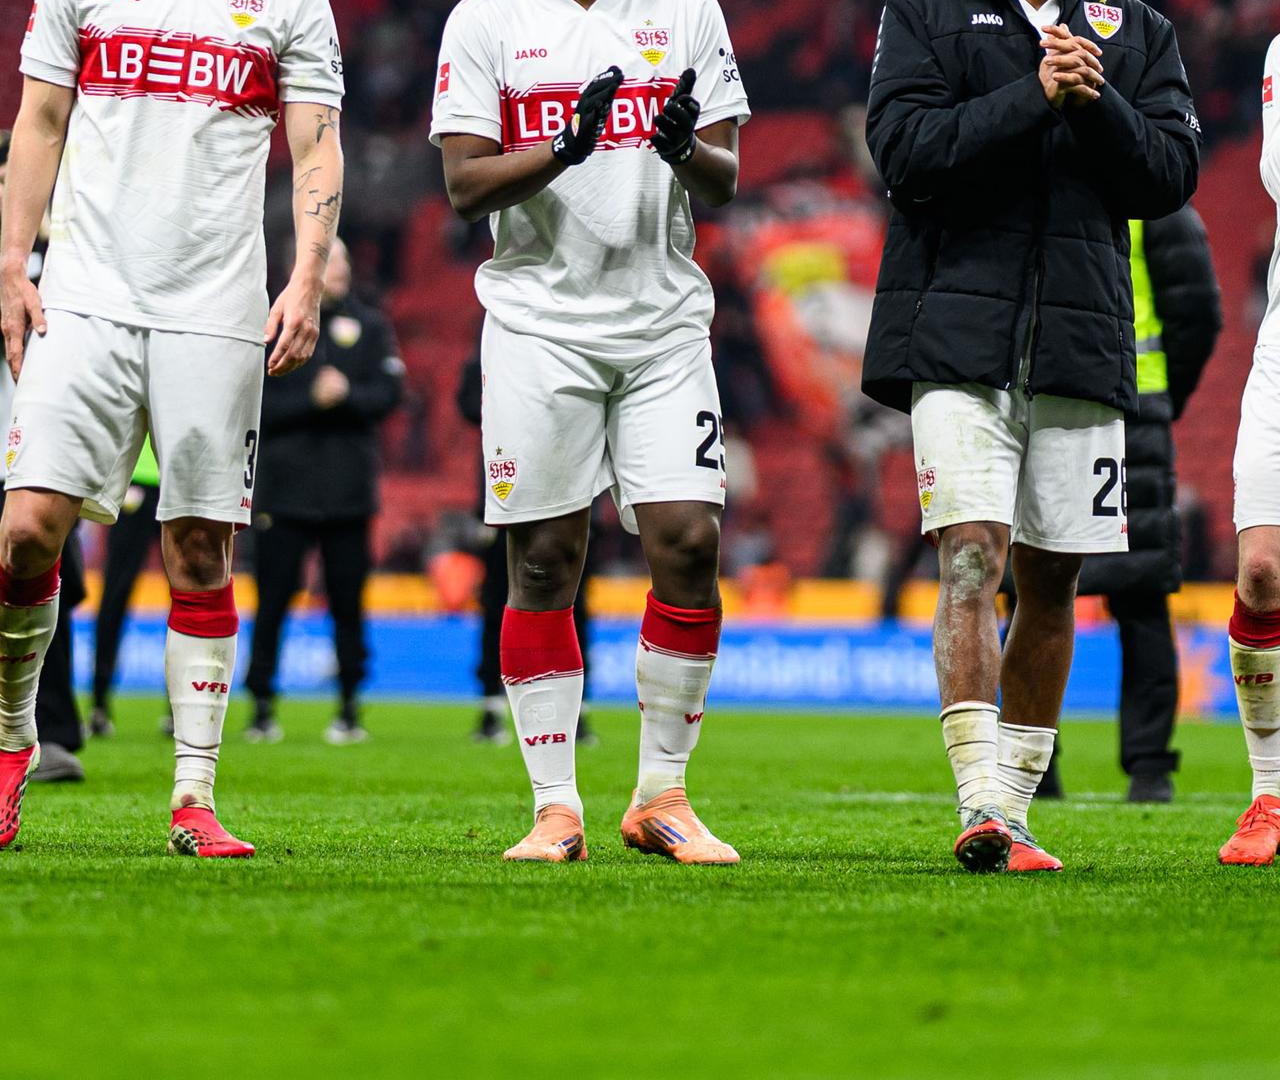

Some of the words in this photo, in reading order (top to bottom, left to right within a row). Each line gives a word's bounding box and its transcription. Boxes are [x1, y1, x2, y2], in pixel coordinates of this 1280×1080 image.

[971, 14, 1003, 26] JAKO
[515, 48, 547, 60] JAKO
[242, 429, 256, 489] 3
[1233, 672, 1272, 685] VfB
[191, 681, 228, 694] VfB
[523, 733, 566, 746] VfB
